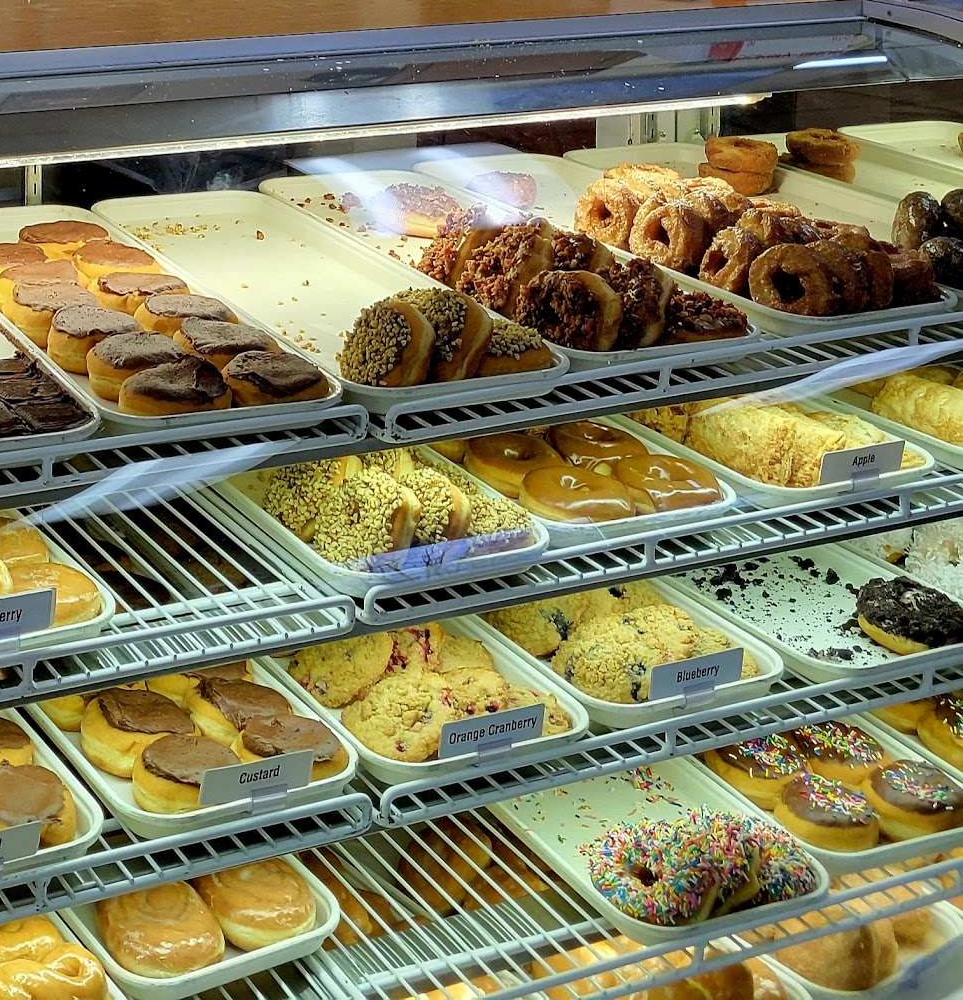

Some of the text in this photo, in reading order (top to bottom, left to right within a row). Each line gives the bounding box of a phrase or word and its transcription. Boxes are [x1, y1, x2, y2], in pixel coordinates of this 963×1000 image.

[851, 453, 876, 468] Apple
[676, 664, 720, 683] Blueberry
[449, 716, 538, 745] Orange Cranberry
[239, 764, 281, 784] Custard
